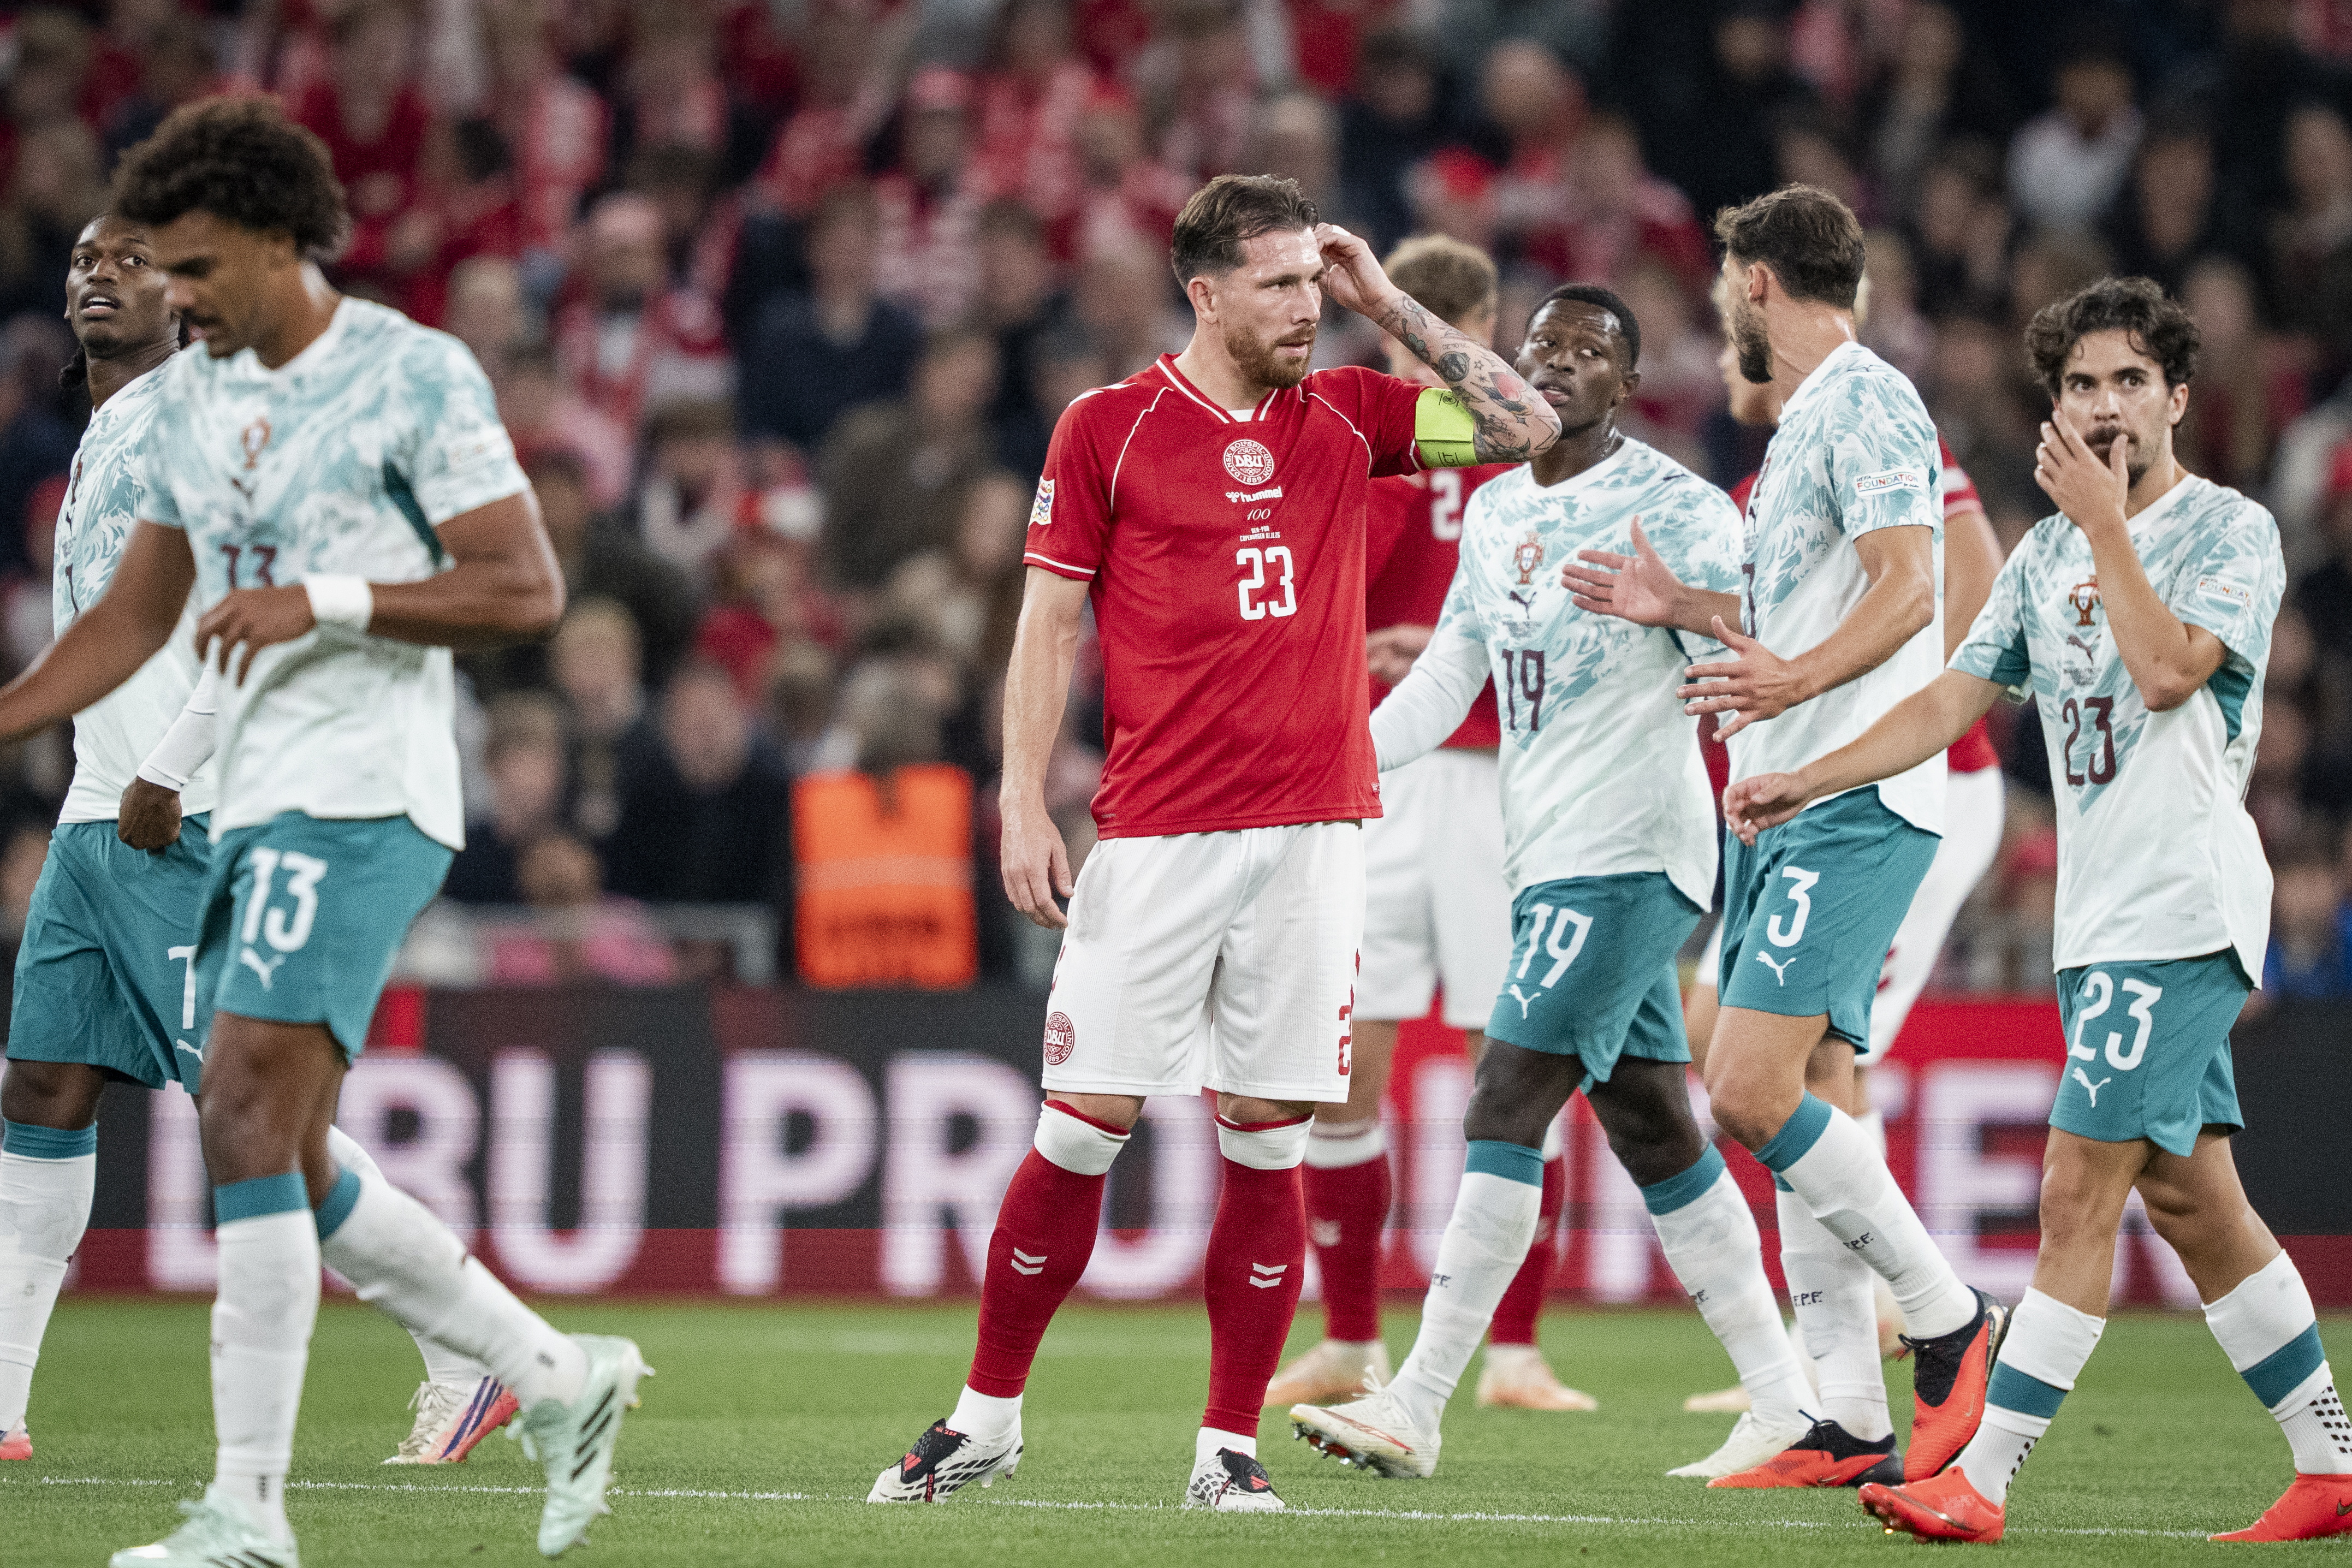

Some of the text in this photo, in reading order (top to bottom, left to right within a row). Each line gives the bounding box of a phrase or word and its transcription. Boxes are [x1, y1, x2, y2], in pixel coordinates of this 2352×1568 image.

[1234, 454, 1264, 467] DBU
[1240, 486, 1282, 502] hummel
[1263, 454, 1272, 477] UNION
[1857, 474, 1918, 489] FOUNDATION
[1246, 508, 1271, 520] 100
[1236, 547, 1297, 621] 23
[1501, 649, 1545, 732] 19
[2062, 696, 2117, 786] 23
[241, 846, 328, 952] 13
[1766, 865, 1820, 947] 3
[1516, 902, 1593, 989] 19
[1046, 1030, 1065, 1046] DBU
[2067, 971, 2163, 1072] 23
